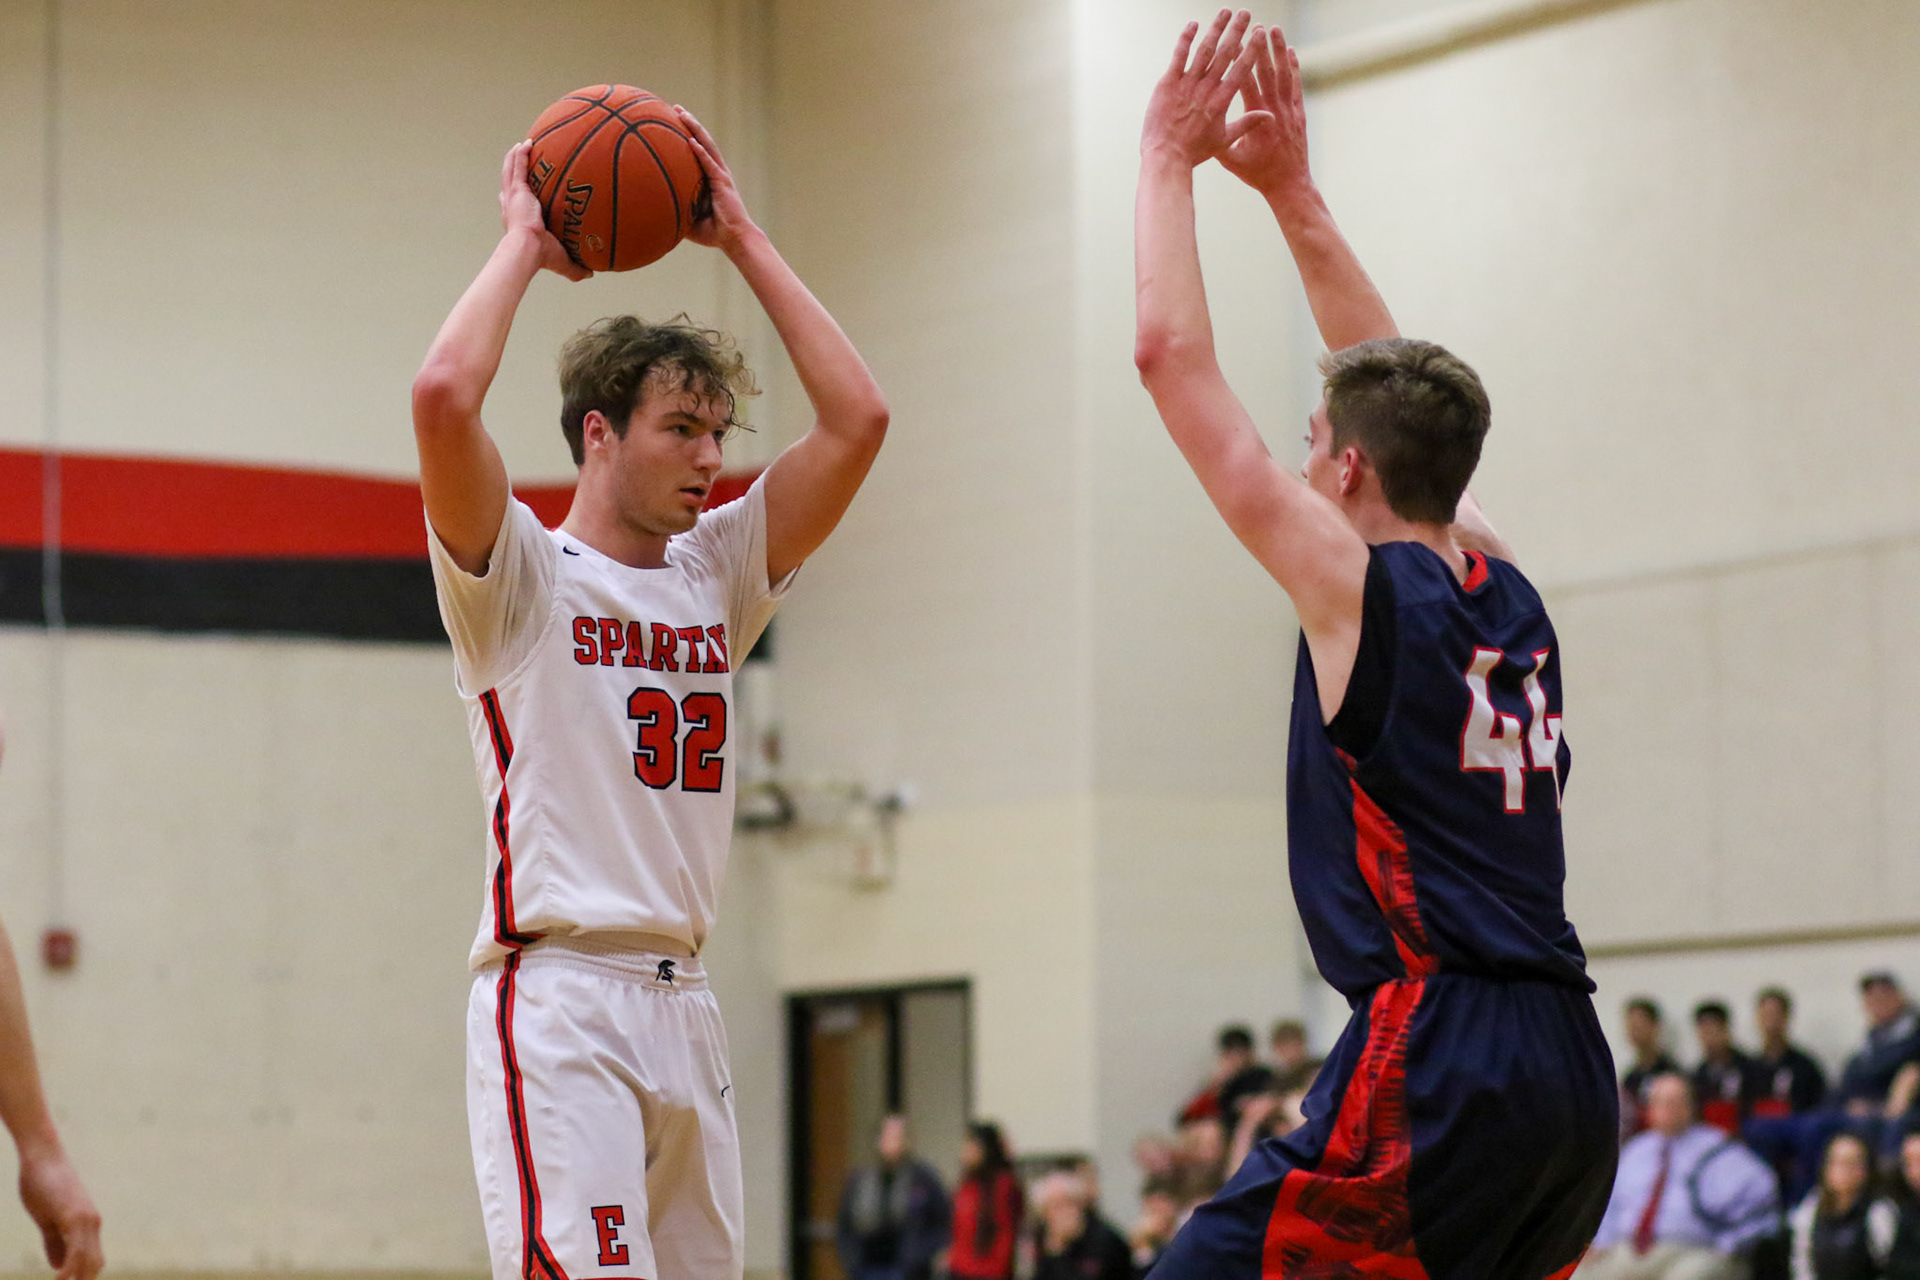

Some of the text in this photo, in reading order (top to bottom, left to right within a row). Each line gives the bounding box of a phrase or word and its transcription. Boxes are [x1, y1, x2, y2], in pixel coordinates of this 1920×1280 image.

[563, 178, 593, 264] SPALD
[627, 686, 727, 793] 32
[1460, 645, 1562, 814] 44
[591, 1205, 630, 1266] E
